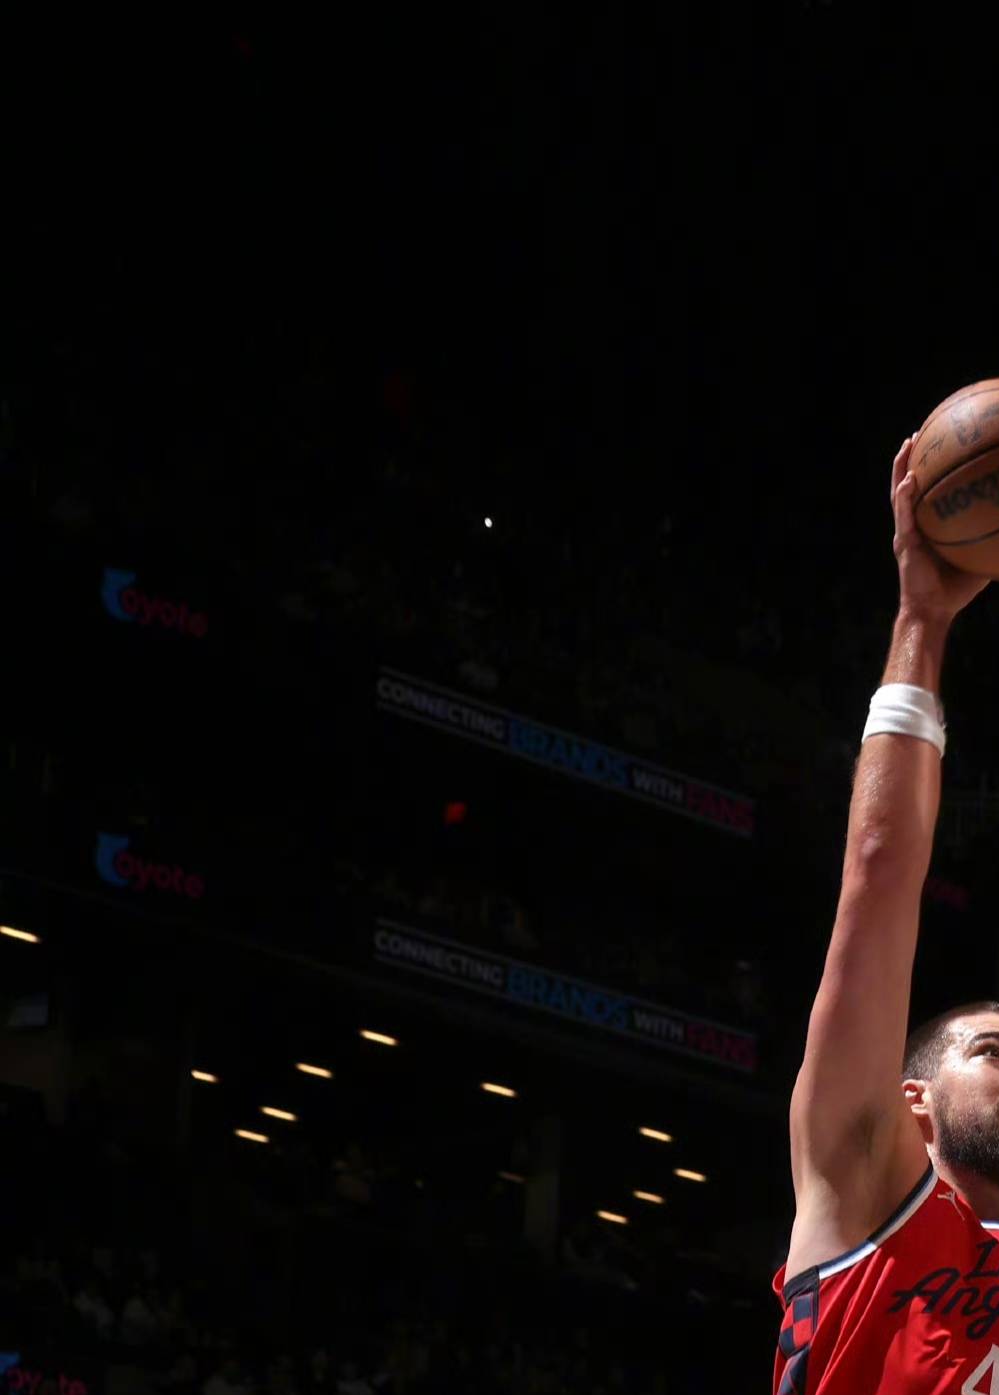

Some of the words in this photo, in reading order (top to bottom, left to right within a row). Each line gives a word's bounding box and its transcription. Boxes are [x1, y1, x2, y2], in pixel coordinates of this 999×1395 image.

[376, 677, 504, 741] CONNECTING
[510, 718, 628, 786] BRANDS
[632, 768, 683, 800] WITH
[374, 929, 504, 986] CONNECTING
[509, 966, 630, 1030] BRANDS
[633, 1009, 683, 1042] WITH
